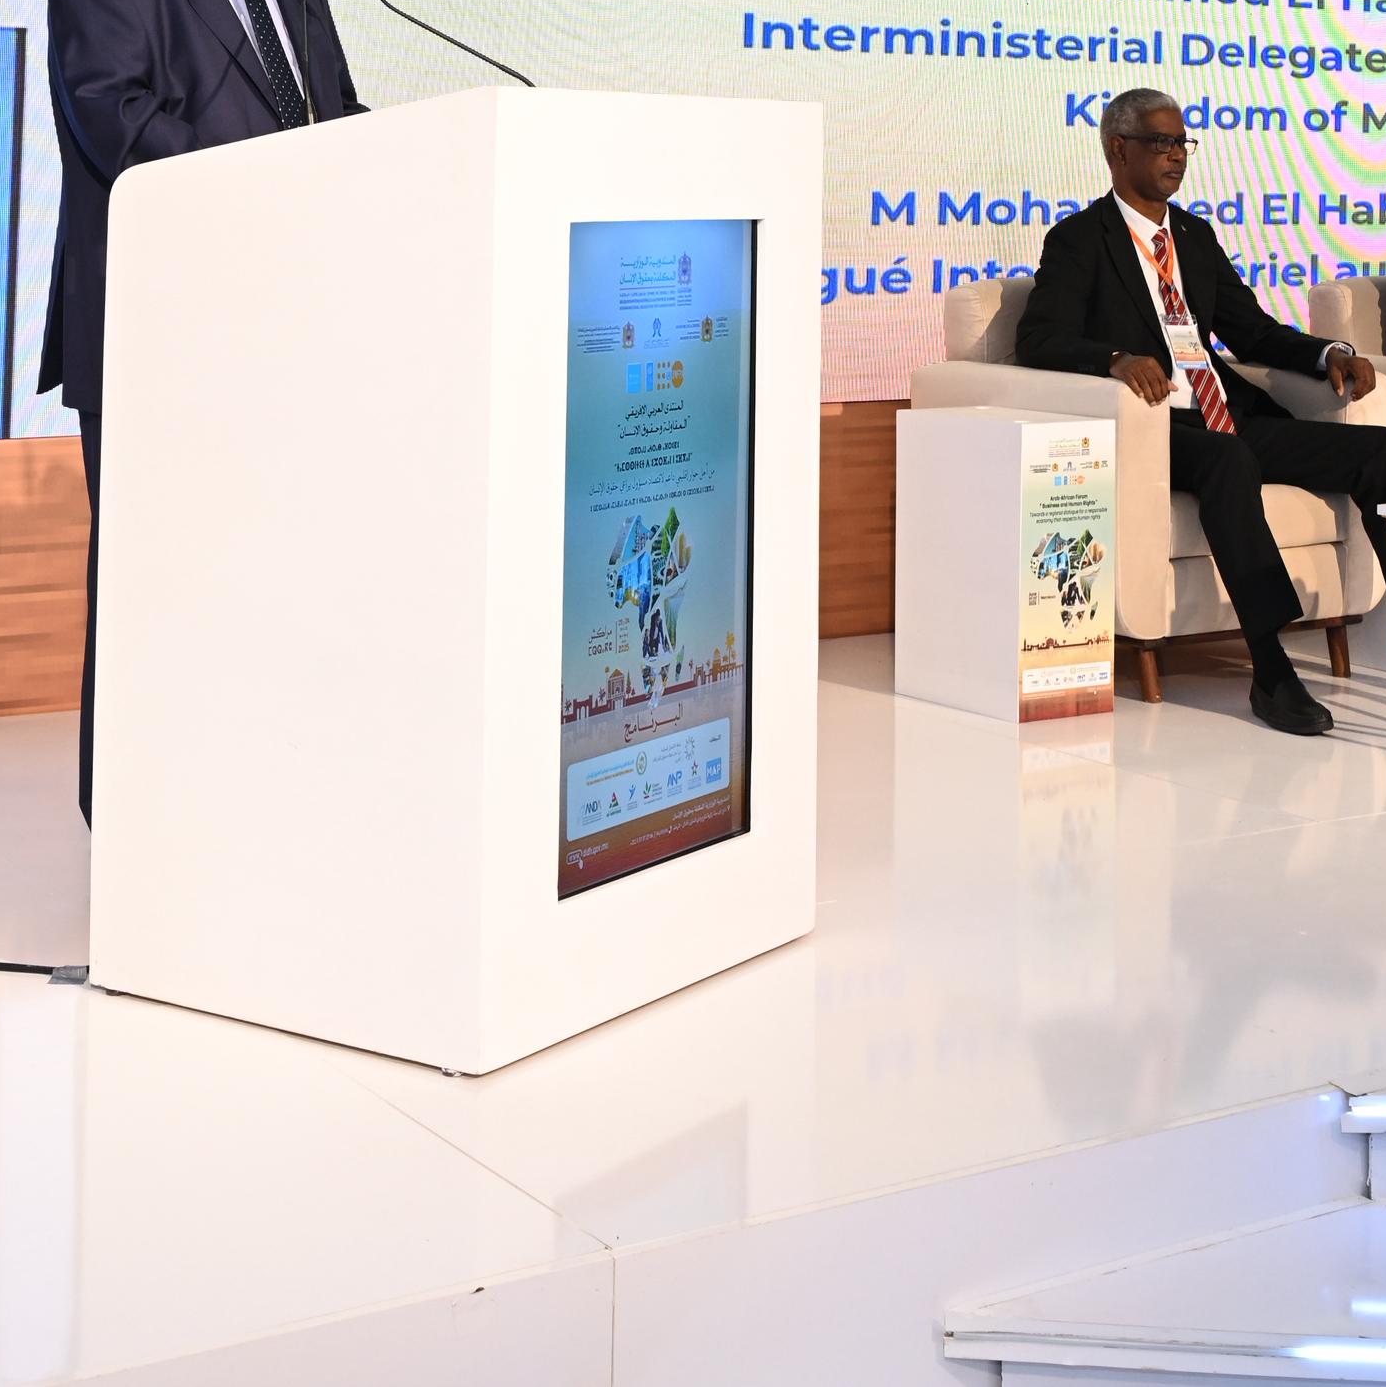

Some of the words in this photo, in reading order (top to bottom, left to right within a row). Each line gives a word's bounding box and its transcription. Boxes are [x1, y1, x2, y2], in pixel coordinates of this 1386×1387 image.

[743, 12, 1164, 65] Interministerial
[1065, 91, 1287, 131] Kidom
[1303, 100, 1348, 132] of
[871, 191, 916, 226] M
[938, 190, 1245, 226] Mohaed
[1262, 192, 1302, 226] El
[624, 701, 683, 743] البرنامج
